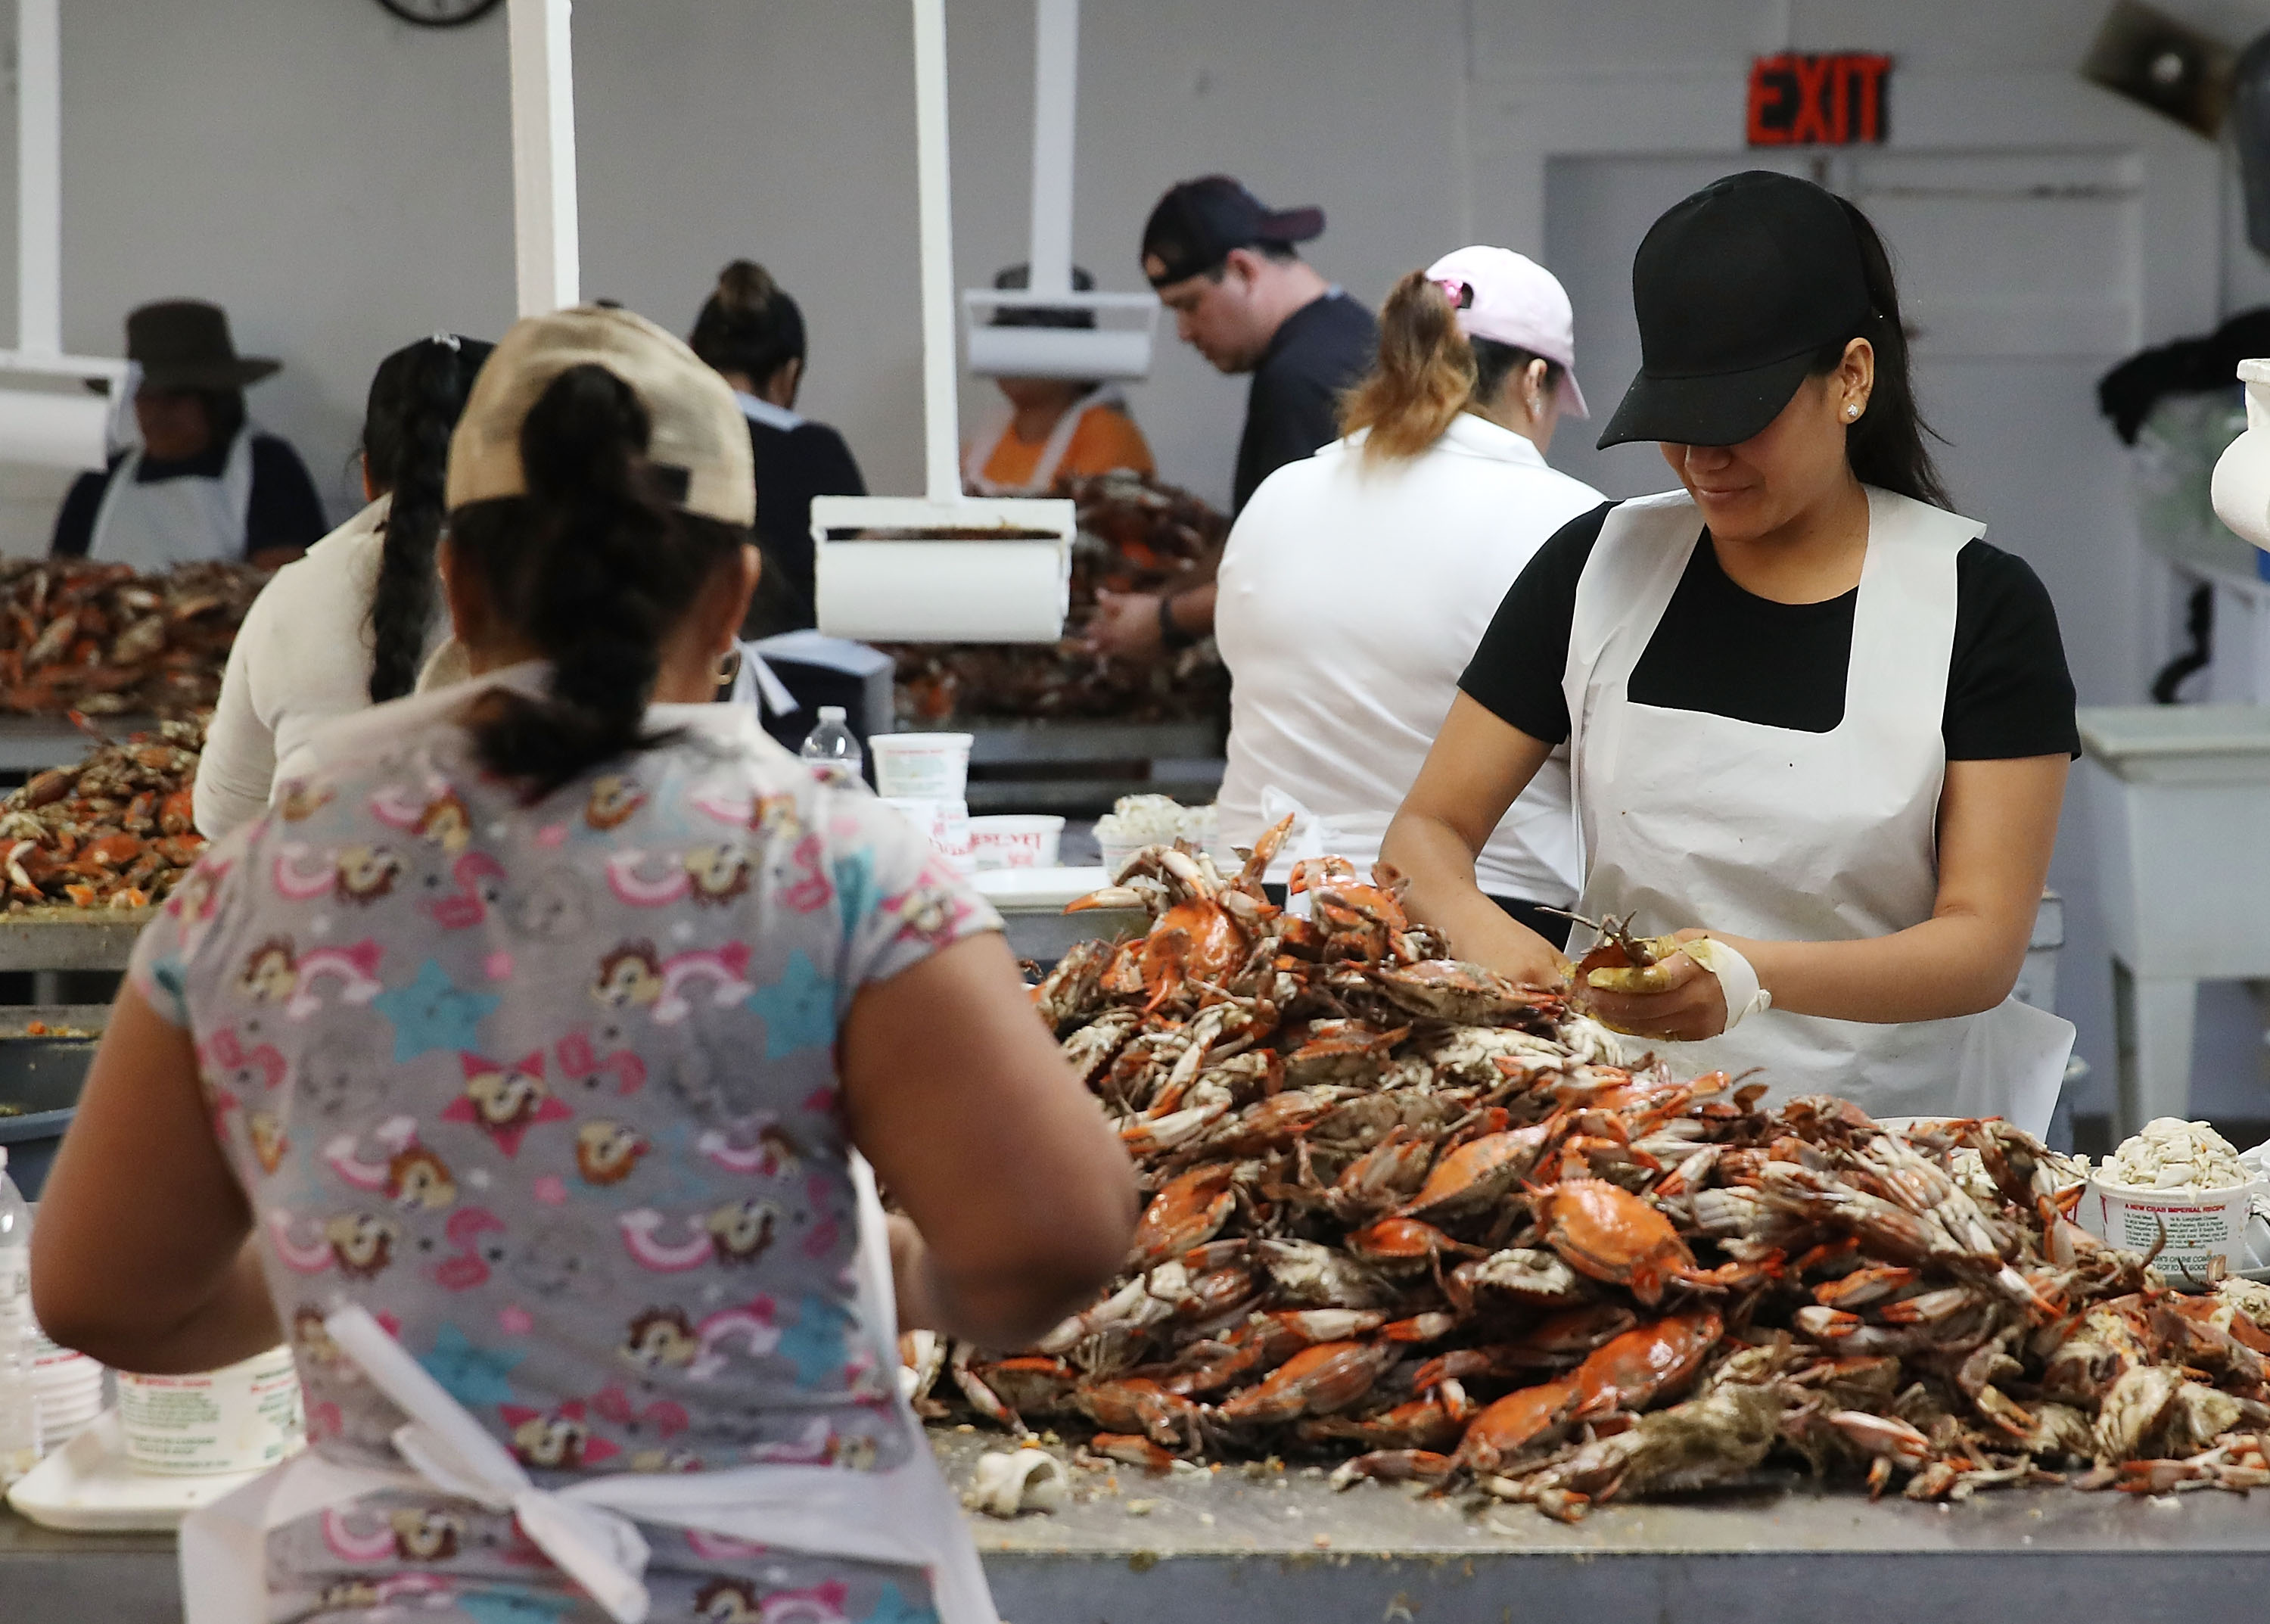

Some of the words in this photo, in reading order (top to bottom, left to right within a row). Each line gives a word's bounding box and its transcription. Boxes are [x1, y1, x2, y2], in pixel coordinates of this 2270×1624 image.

[1746, 54, 1892, 145] EXIT
[2156, 1262, 2169, 1271] GOT
[2170, 1263, 2179, 1271] TO
